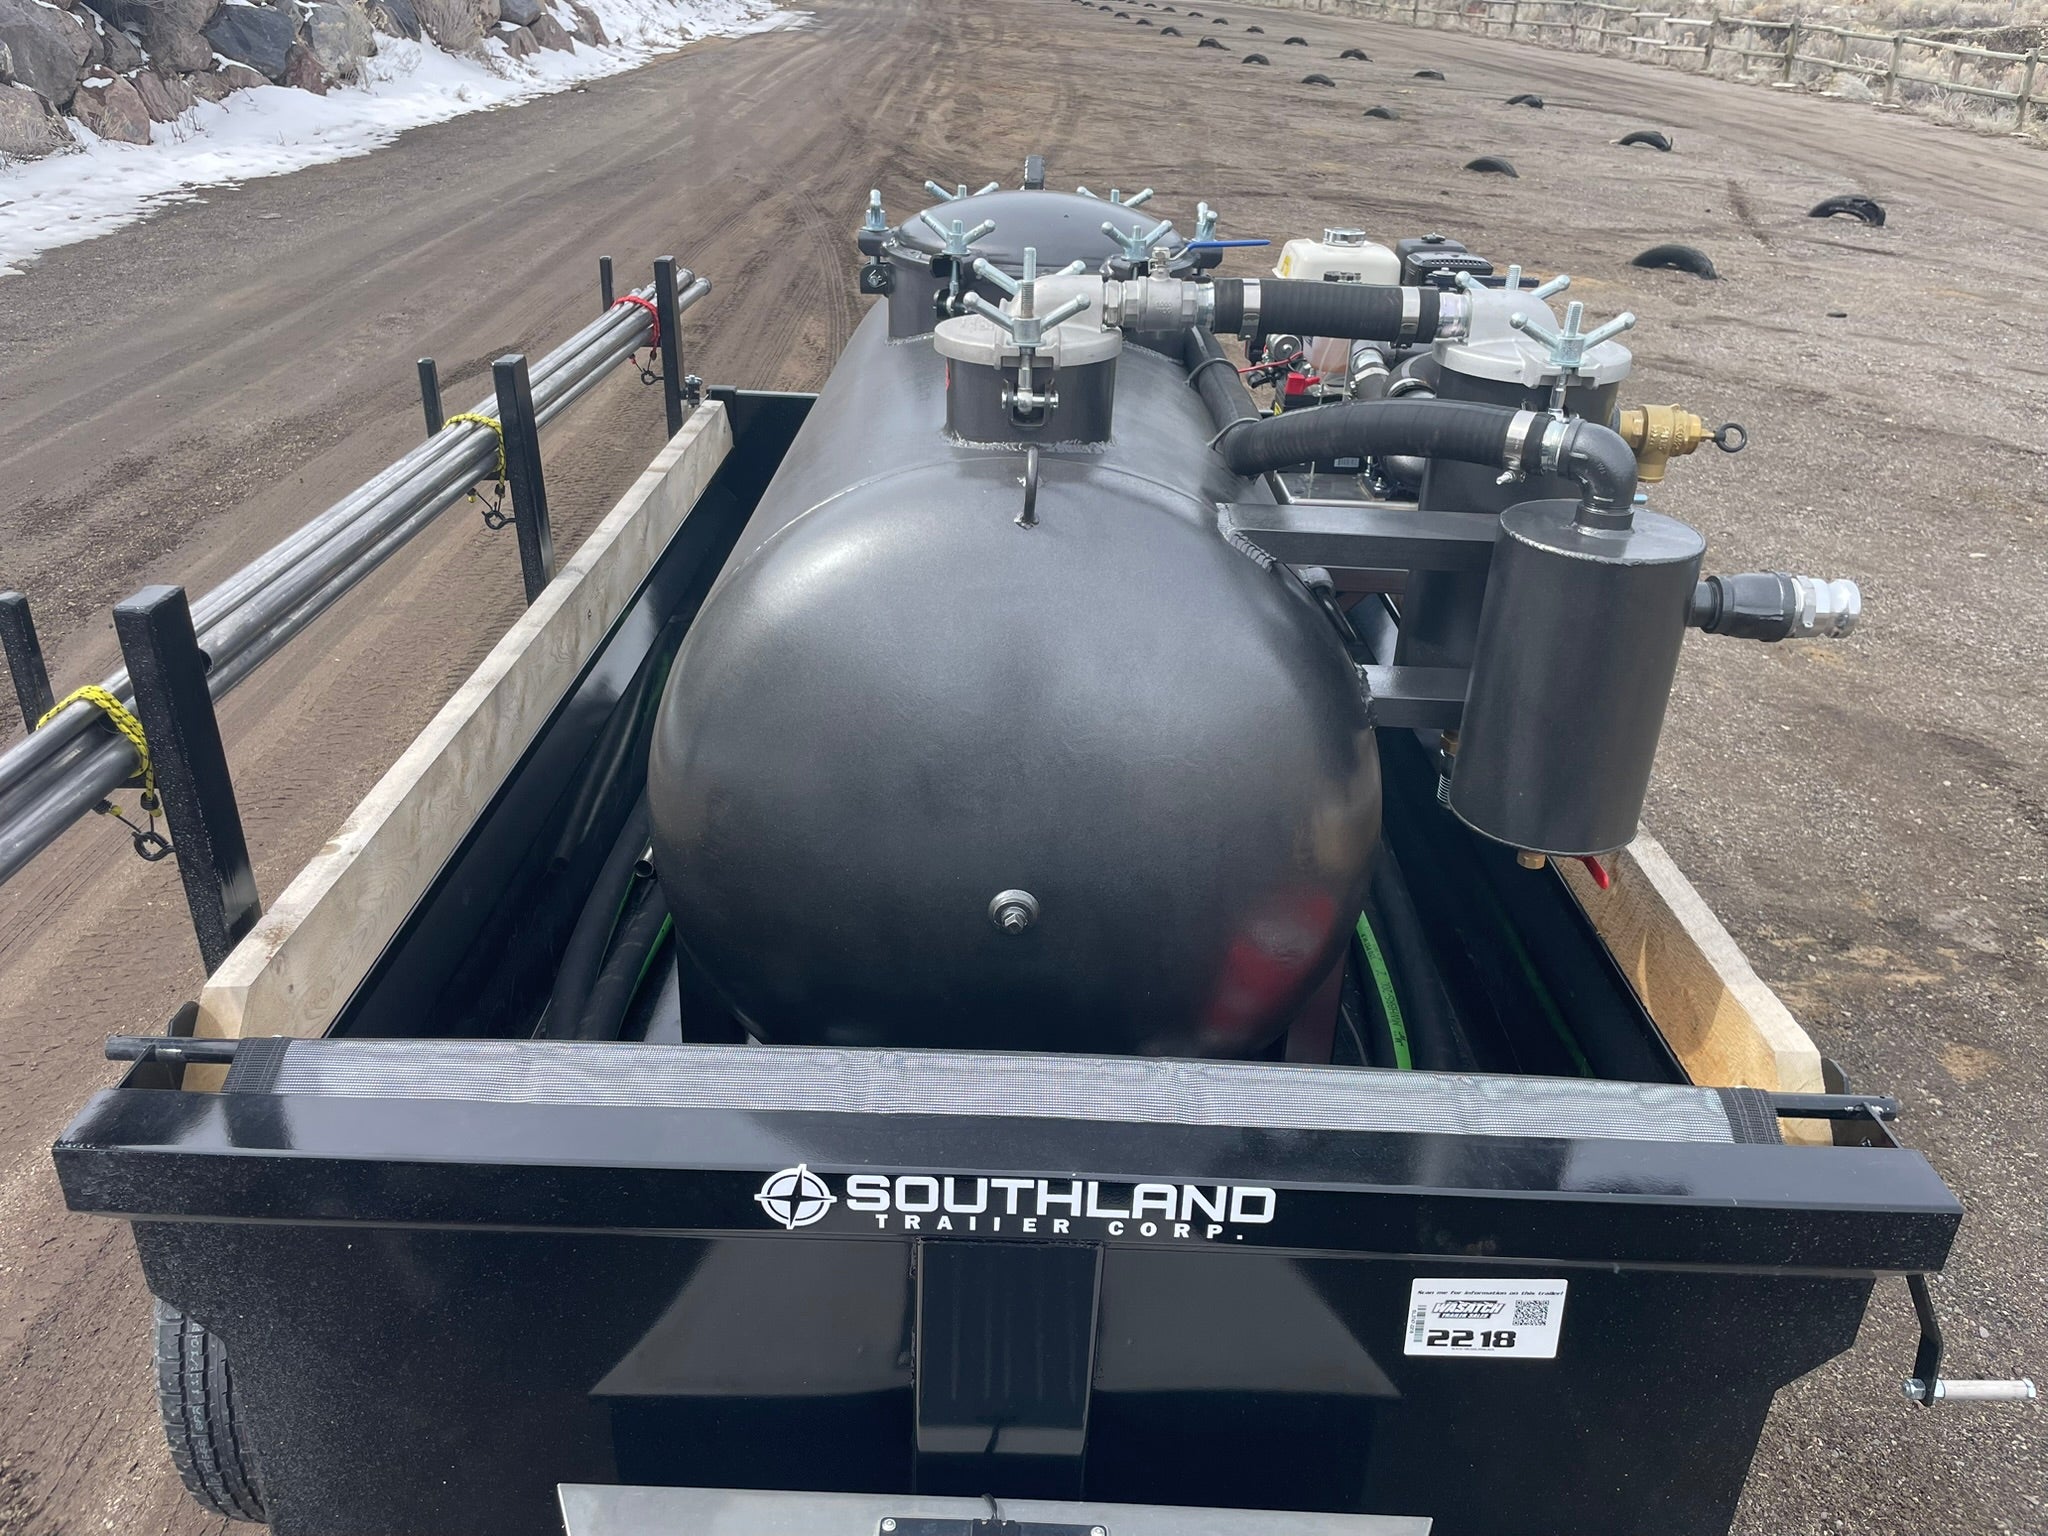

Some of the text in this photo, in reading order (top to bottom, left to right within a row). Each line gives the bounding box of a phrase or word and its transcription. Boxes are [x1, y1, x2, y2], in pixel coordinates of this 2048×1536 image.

[846, 1174, 1276, 1224] SOUTHLAND
[1108, 1221, 1243, 1240] CORP.
[1432, 1301, 1505, 1314] WASATCH
